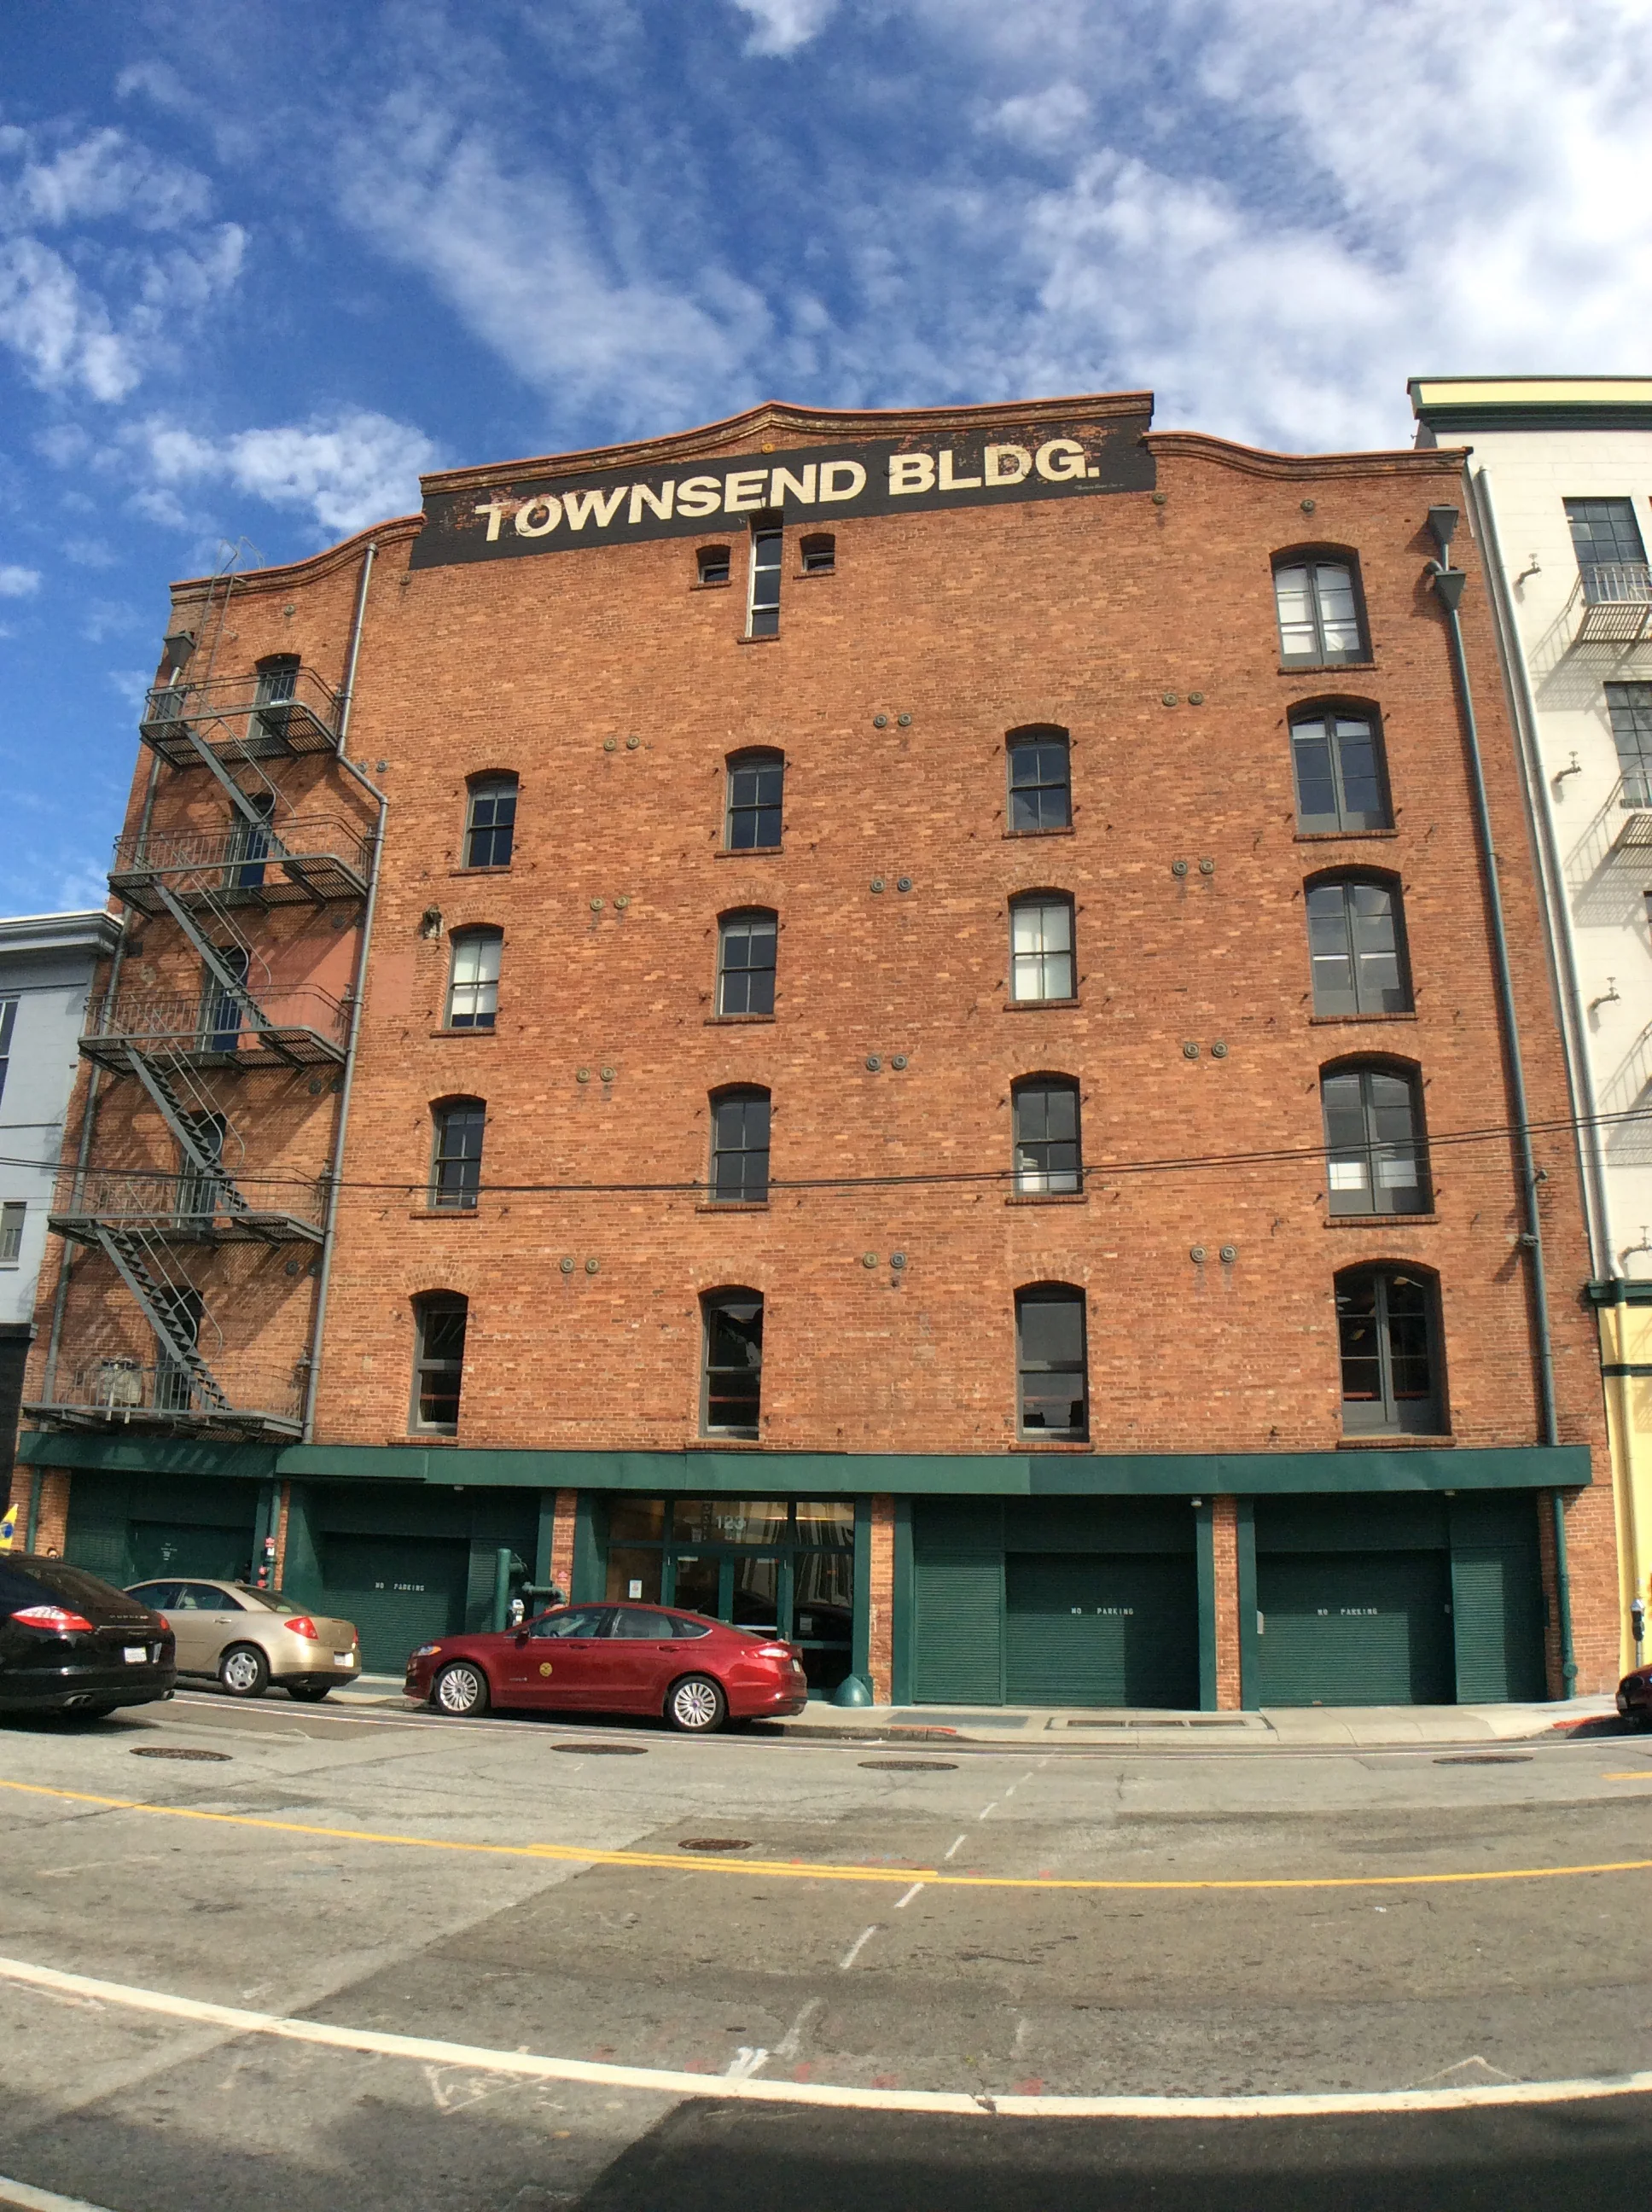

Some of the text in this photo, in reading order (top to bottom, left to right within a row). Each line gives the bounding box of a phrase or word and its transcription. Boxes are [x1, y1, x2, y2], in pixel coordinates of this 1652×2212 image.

[474, 439, 1100, 542] TOWNSEND BLDG.
[716, 1515, 745, 1530] 123
[393, 1583, 425, 1592] PARKING
[1096, 1607, 1134, 1615] PARKING
